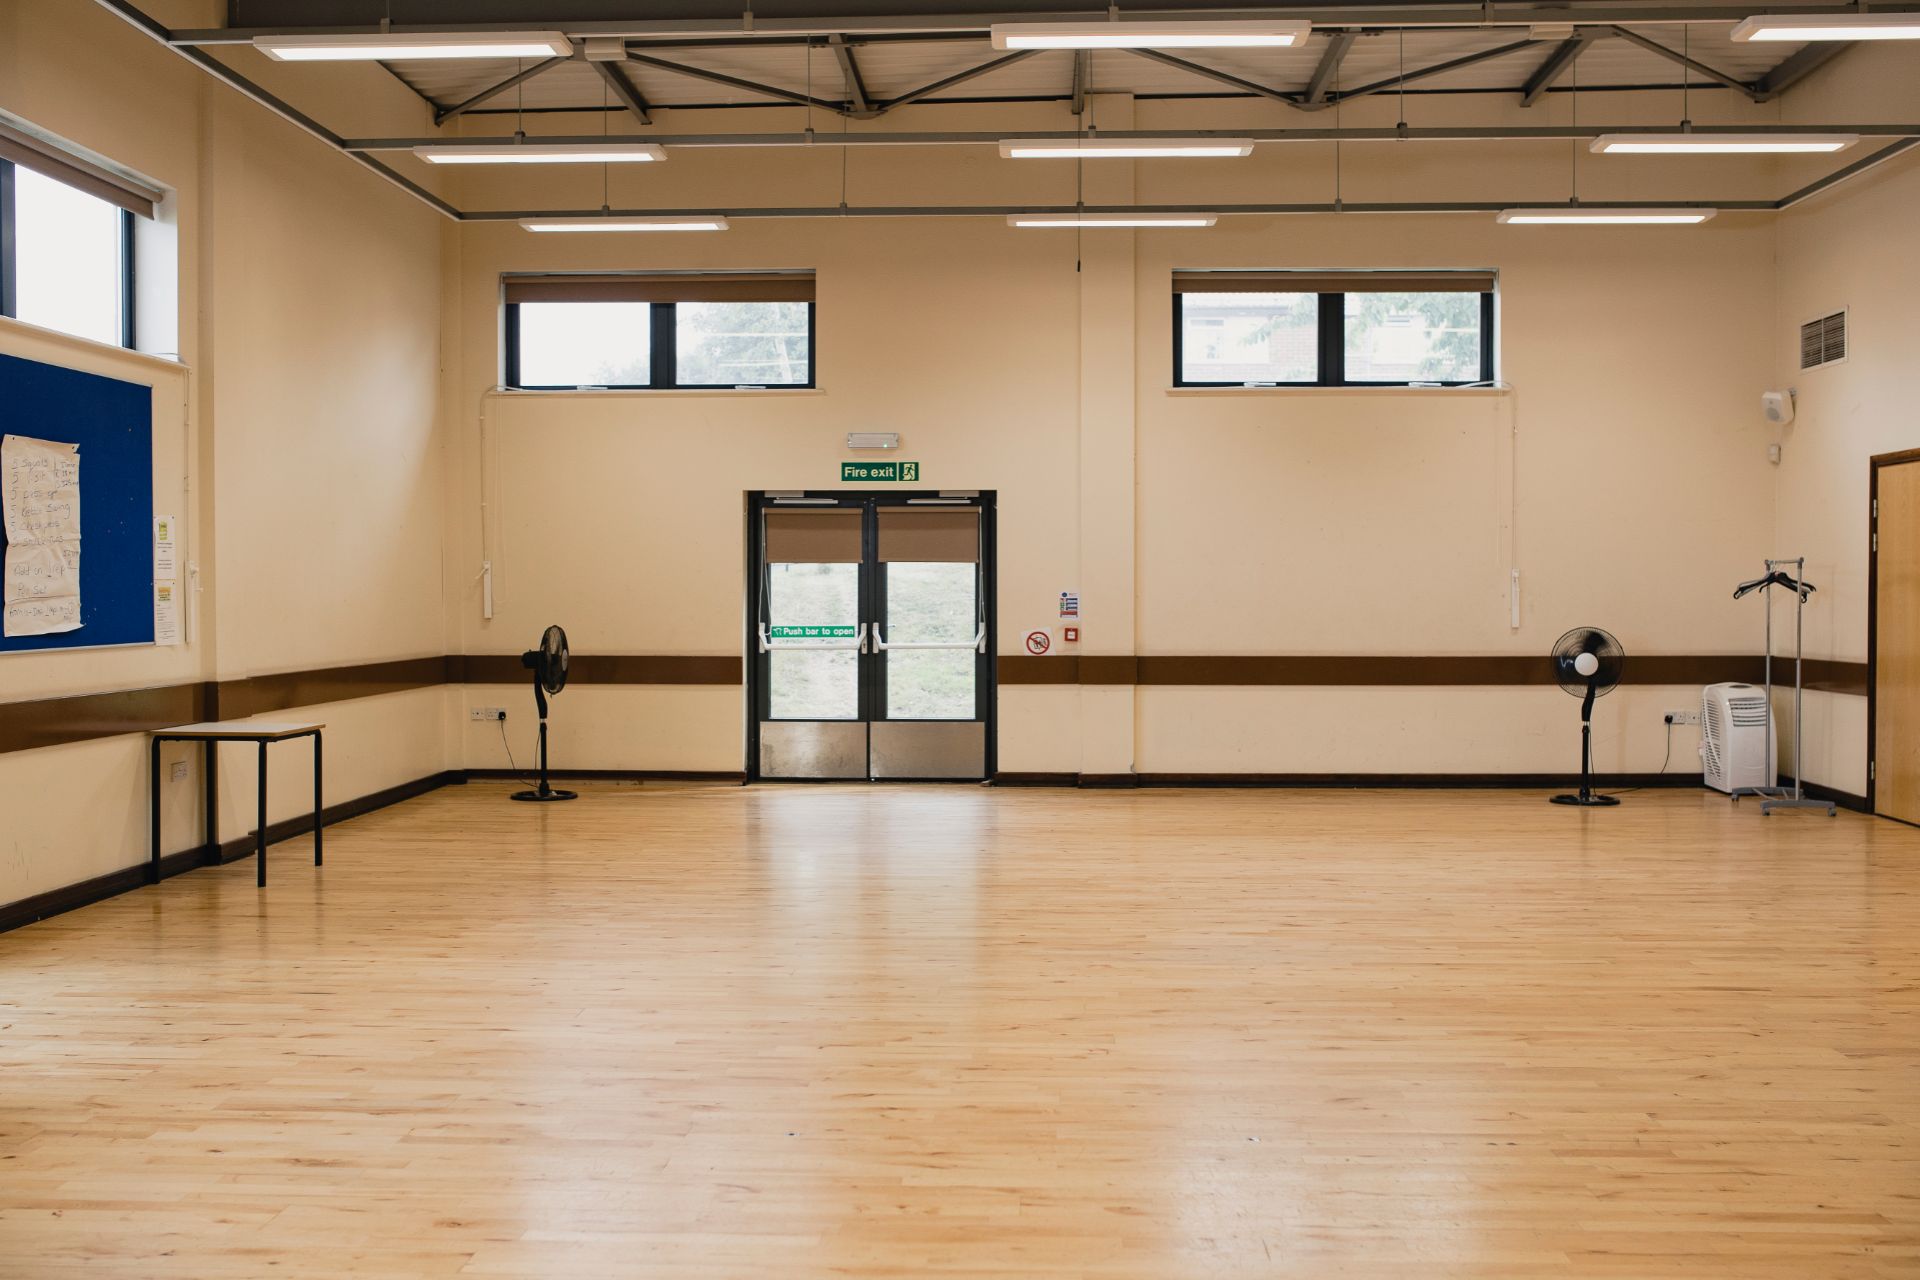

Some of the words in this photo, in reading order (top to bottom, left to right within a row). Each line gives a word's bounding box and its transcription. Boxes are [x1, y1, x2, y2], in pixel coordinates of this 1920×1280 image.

[844, 466, 868, 478] Fire
[870, 466, 894, 478] exit
[783, 627, 803, 636] Push
[805, 627, 819, 636] bar
[821, 627, 831, 636] to
[833, 628, 854, 637] open
